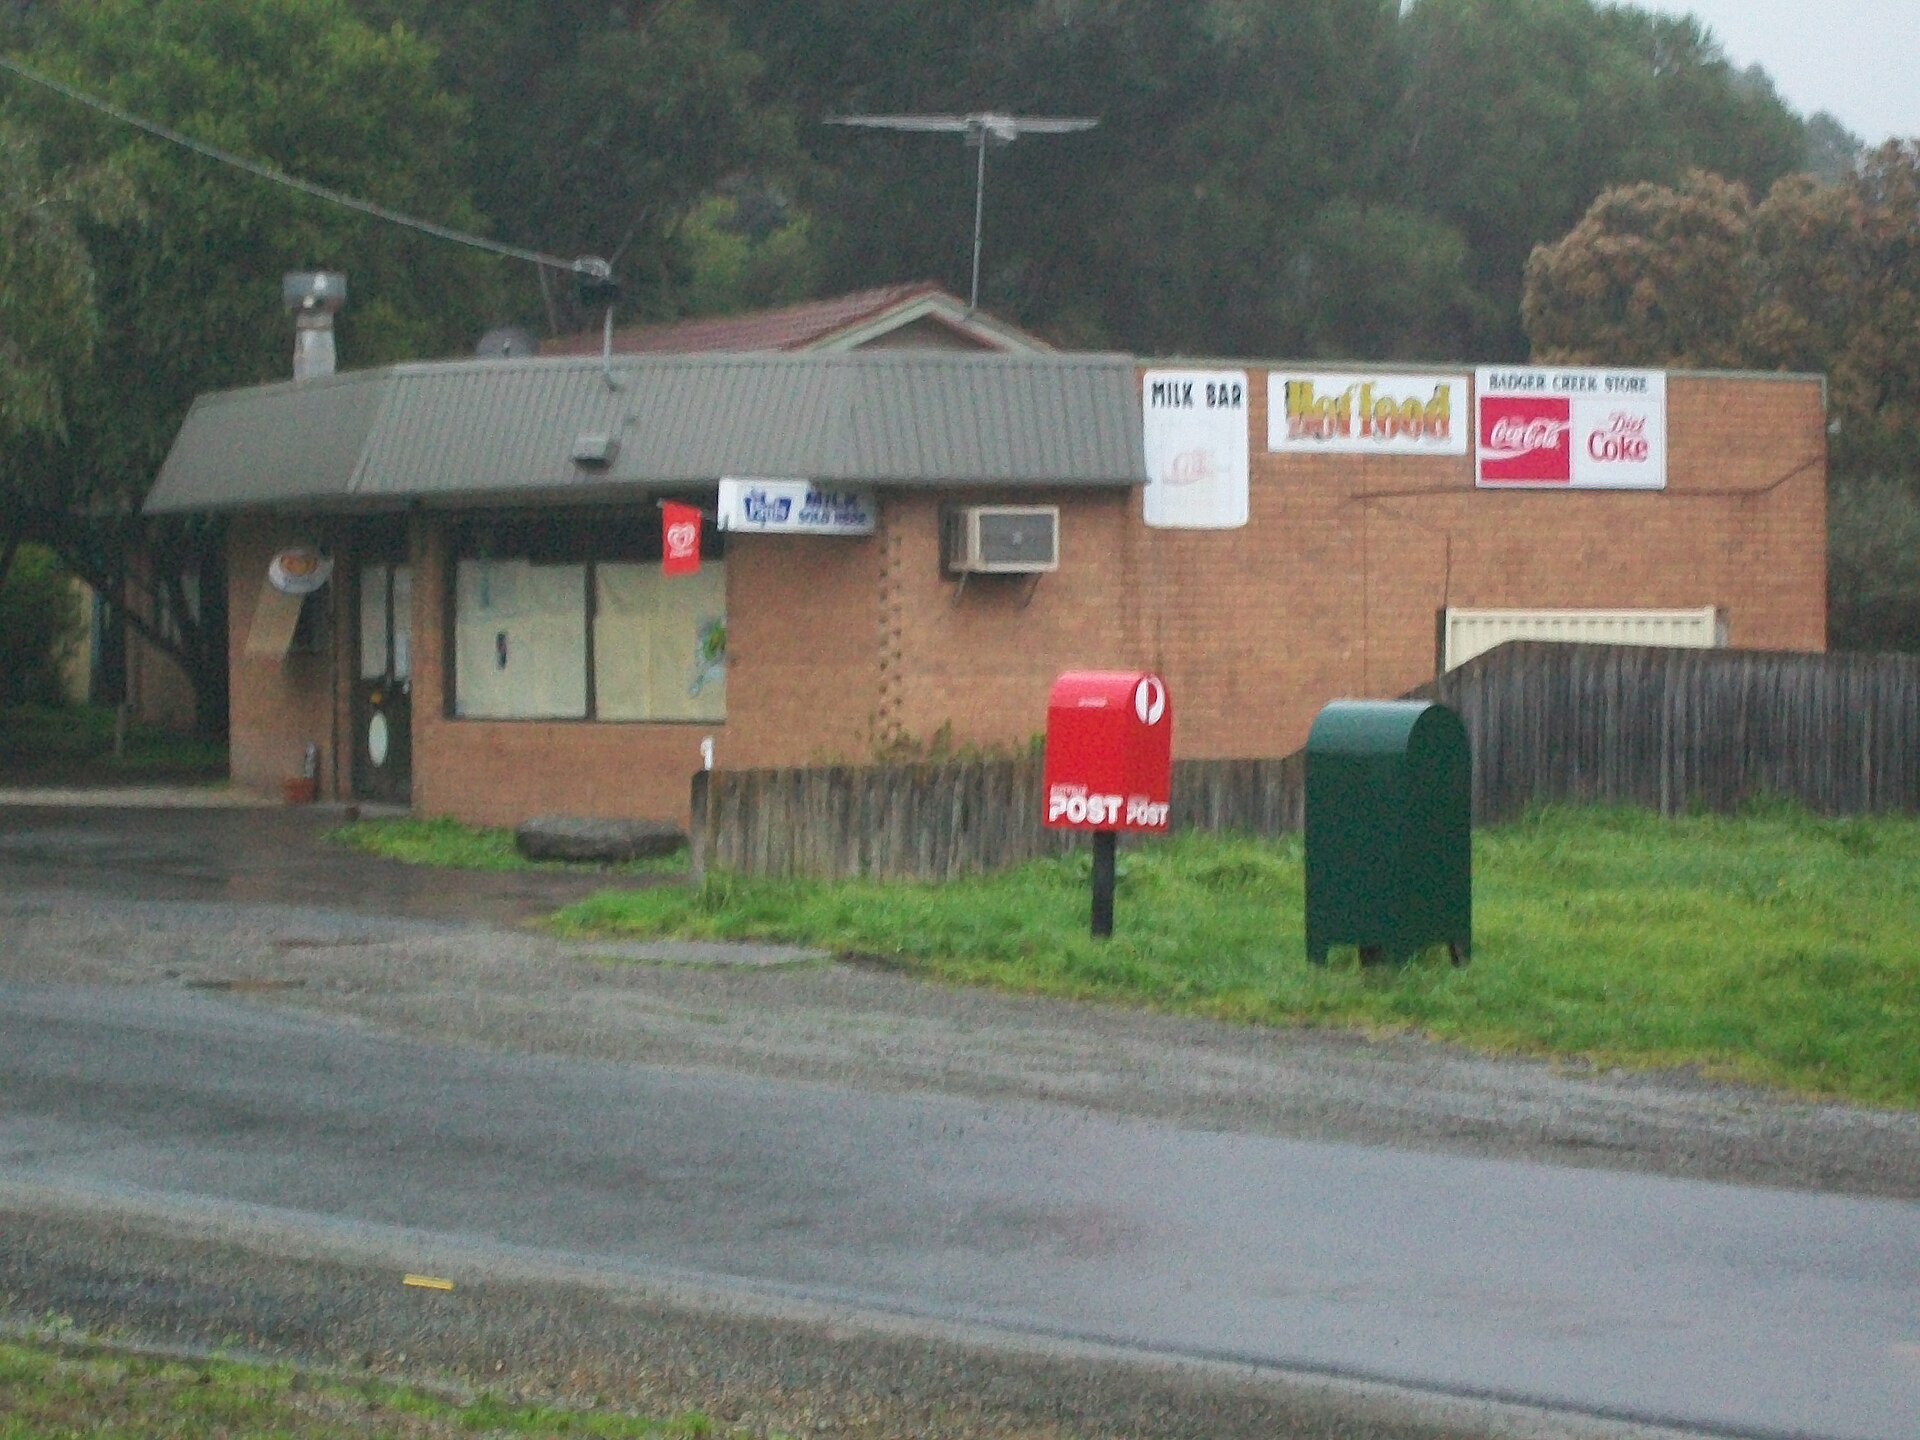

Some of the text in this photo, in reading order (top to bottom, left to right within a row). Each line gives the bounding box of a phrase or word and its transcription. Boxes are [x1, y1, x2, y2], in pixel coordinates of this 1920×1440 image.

[1151, 382, 1242, 409] MILK BAR
[1552, 375, 1597, 392] CREEK
[1604, 376, 1648, 393] STORE
[1586, 429, 1650, 463] Coke
[1049, 794, 1125, 825] POST
[1126, 802, 1171, 827] POST
